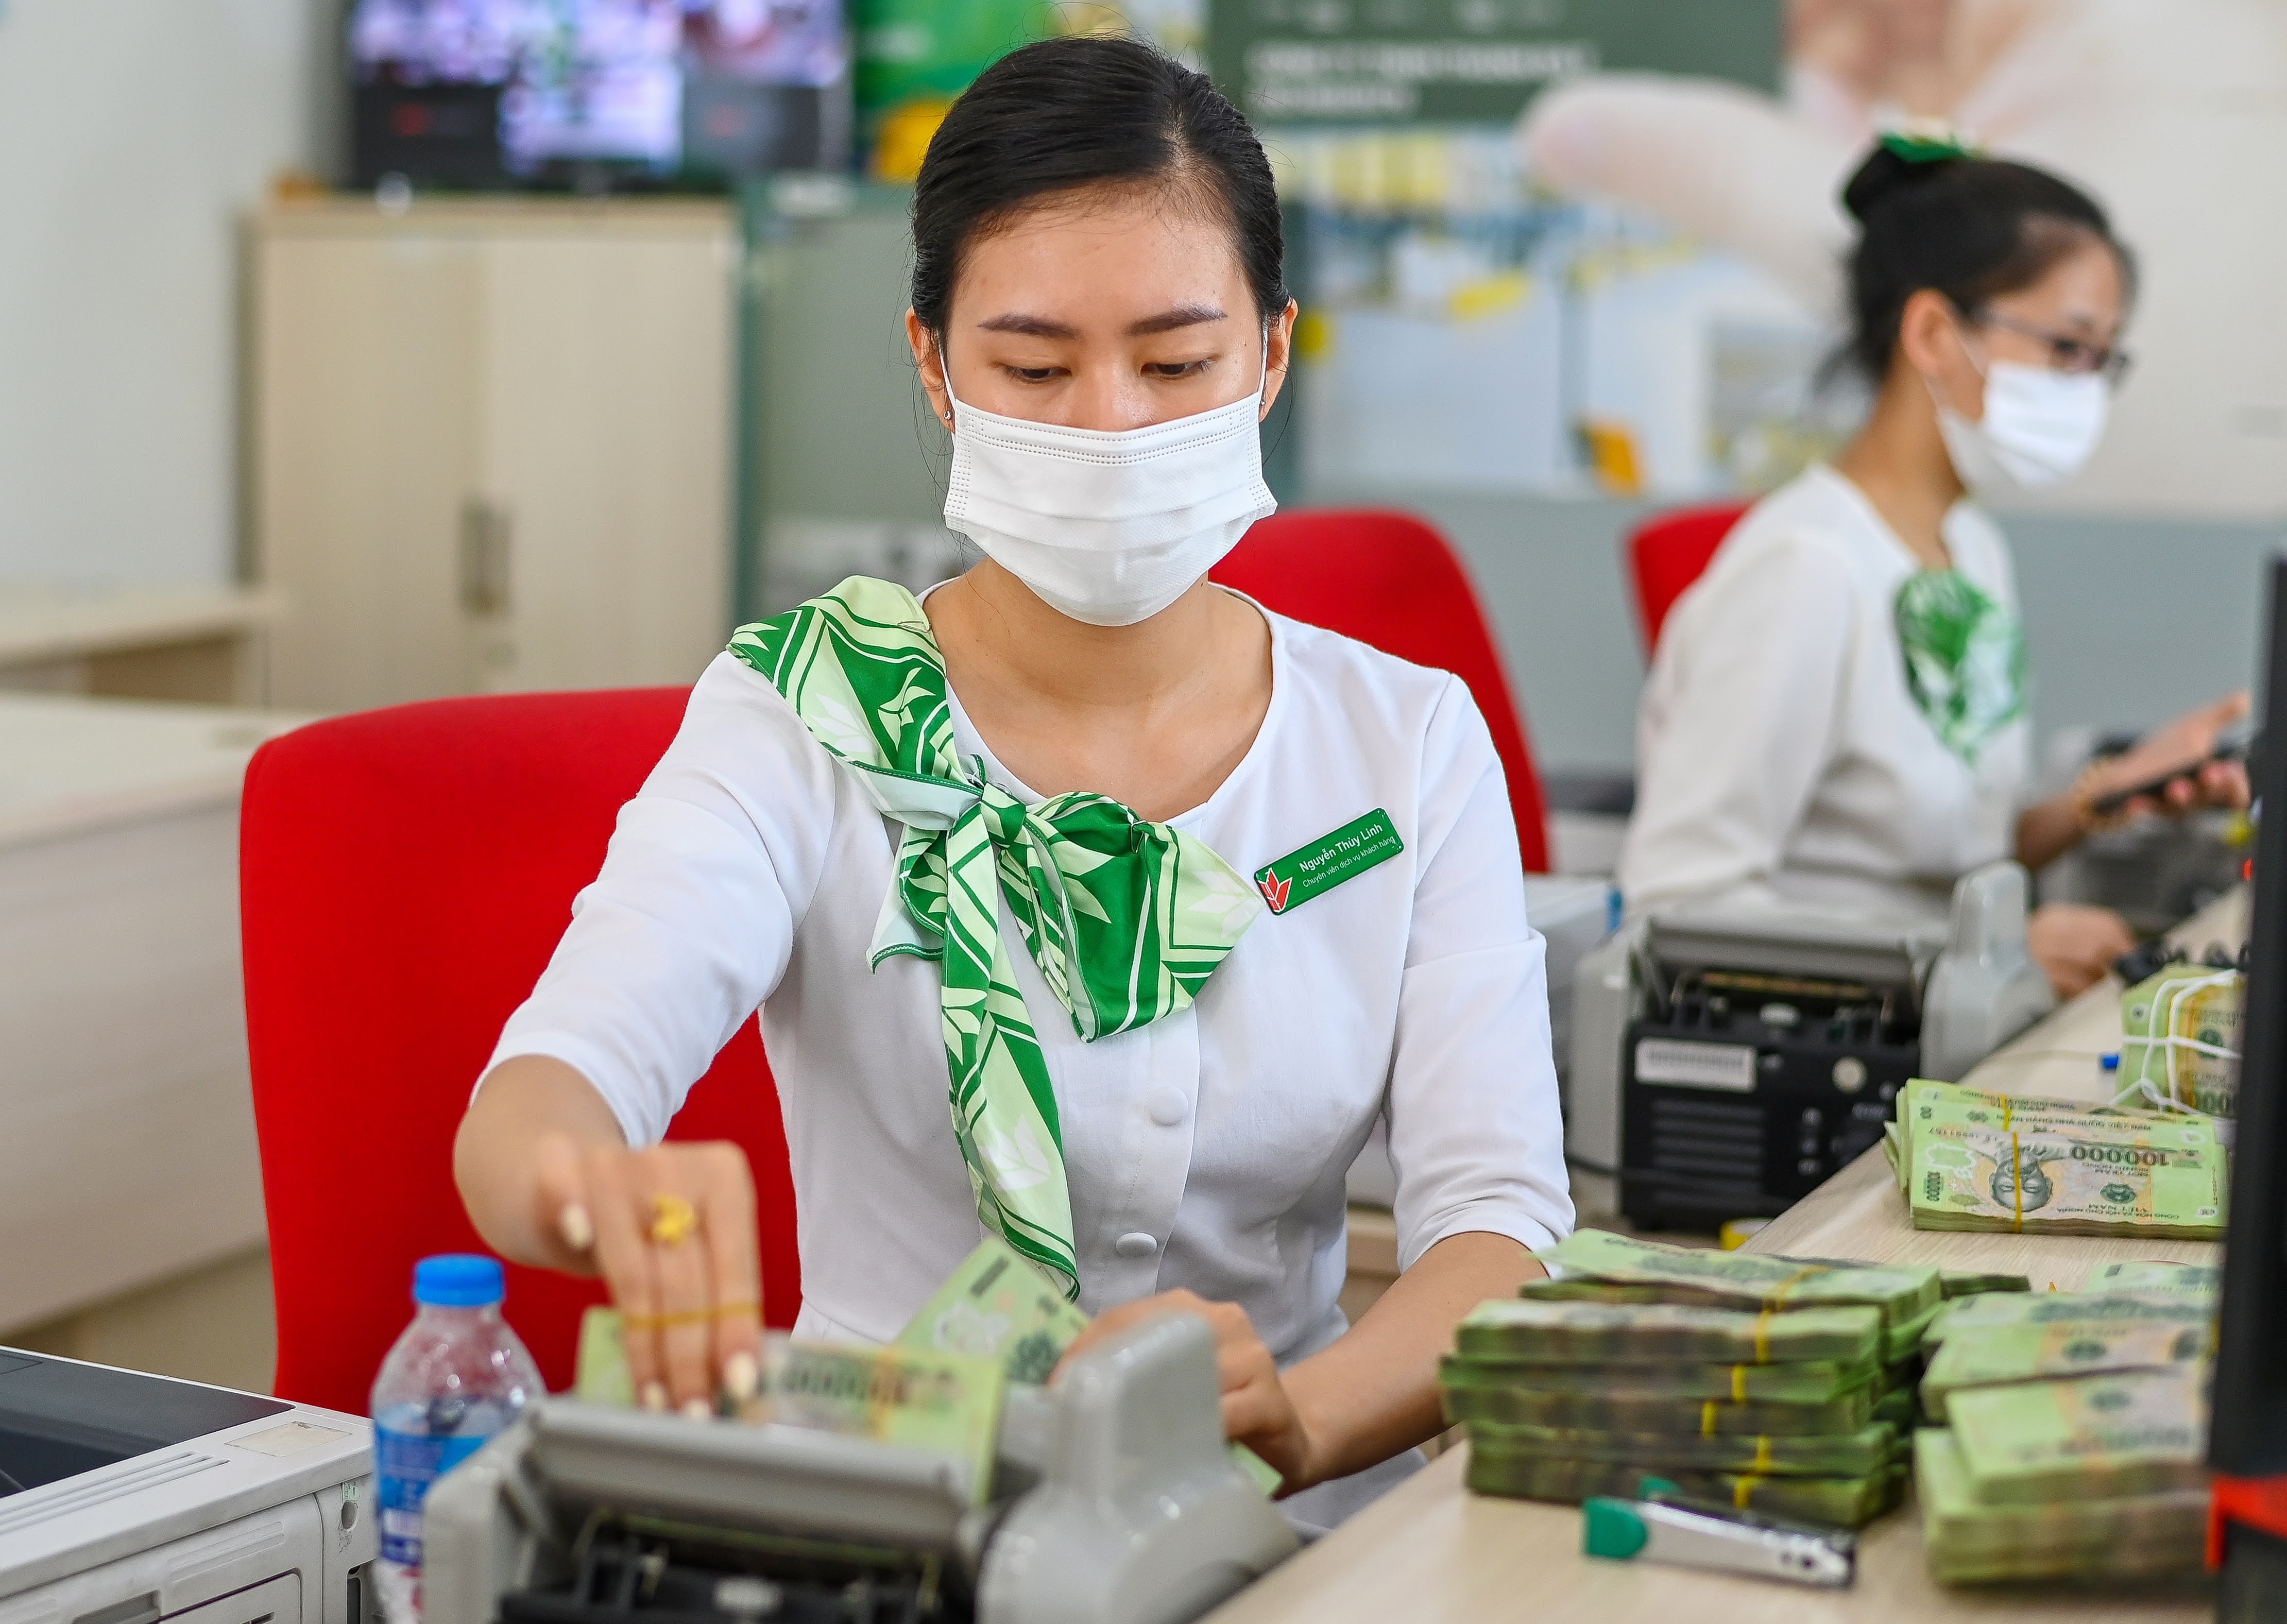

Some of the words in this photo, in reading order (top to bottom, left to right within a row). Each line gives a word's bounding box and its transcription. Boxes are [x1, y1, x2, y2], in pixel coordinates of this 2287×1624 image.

[1299, 848, 1337, 873] Nguyễn
[1335, 835, 1360, 853] Thùy
[1360, 824, 1383, 841] Linh
[1303, 872, 1326, 887] Chuyên
[1326, 865, 1340, 875] viên
[1339, 858, 1353, 868] dịch
[1352, 853, 1360, 862] vụ
[1360, 844, 1379, 858] khách
[2070, 1146, 2169, 1166] 100000
